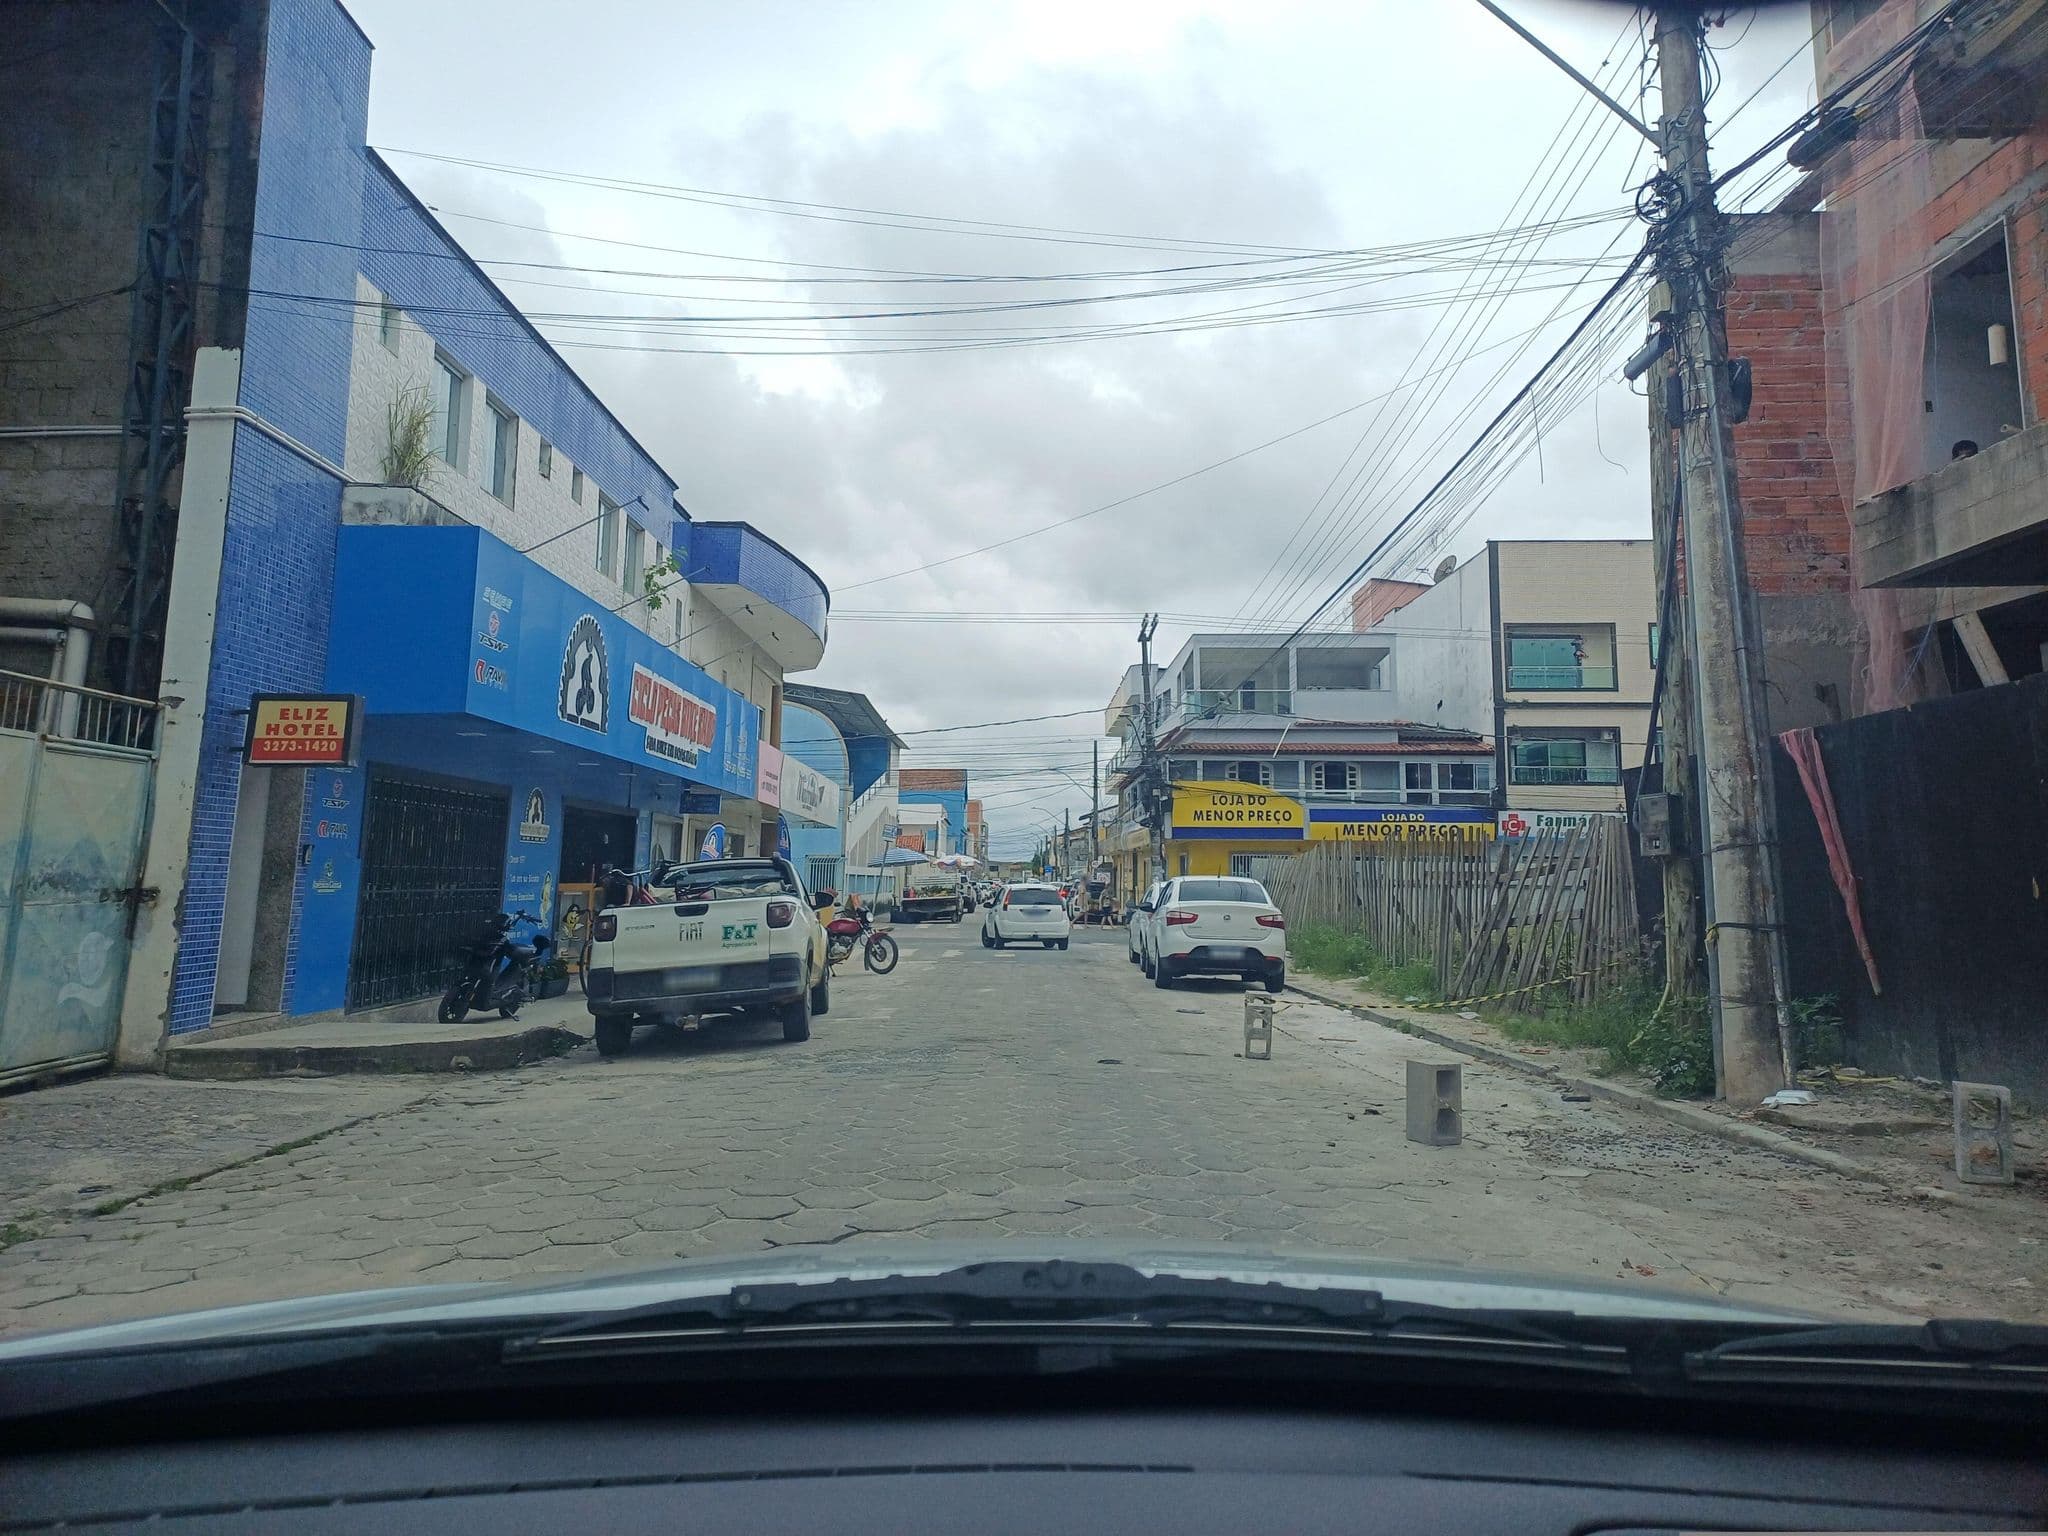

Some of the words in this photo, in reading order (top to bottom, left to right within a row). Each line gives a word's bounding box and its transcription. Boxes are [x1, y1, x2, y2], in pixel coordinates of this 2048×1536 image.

[280, 708, 329, 720] ELIZ
[266, 723, 337, 736] HOTEL
[263, 741, 337, 752] 3273-1420
[1212, 795, 1244, 806] LOJA
[1248, 795, 1267, 806] DO
[1193, 810, 1244, 822] MENOR
[1248, 810, 1292, 824] PREÇO
[1381, 813, 1407, 822] LOJA
[1410, 813, 1425, 822] DO
[1537, 814, 1590, 827] Farmá
[1343, 824, 1402, 836] MENOR
[680, 922, 704, 941] FIAT
[722, 924, 757, 940] F&T
